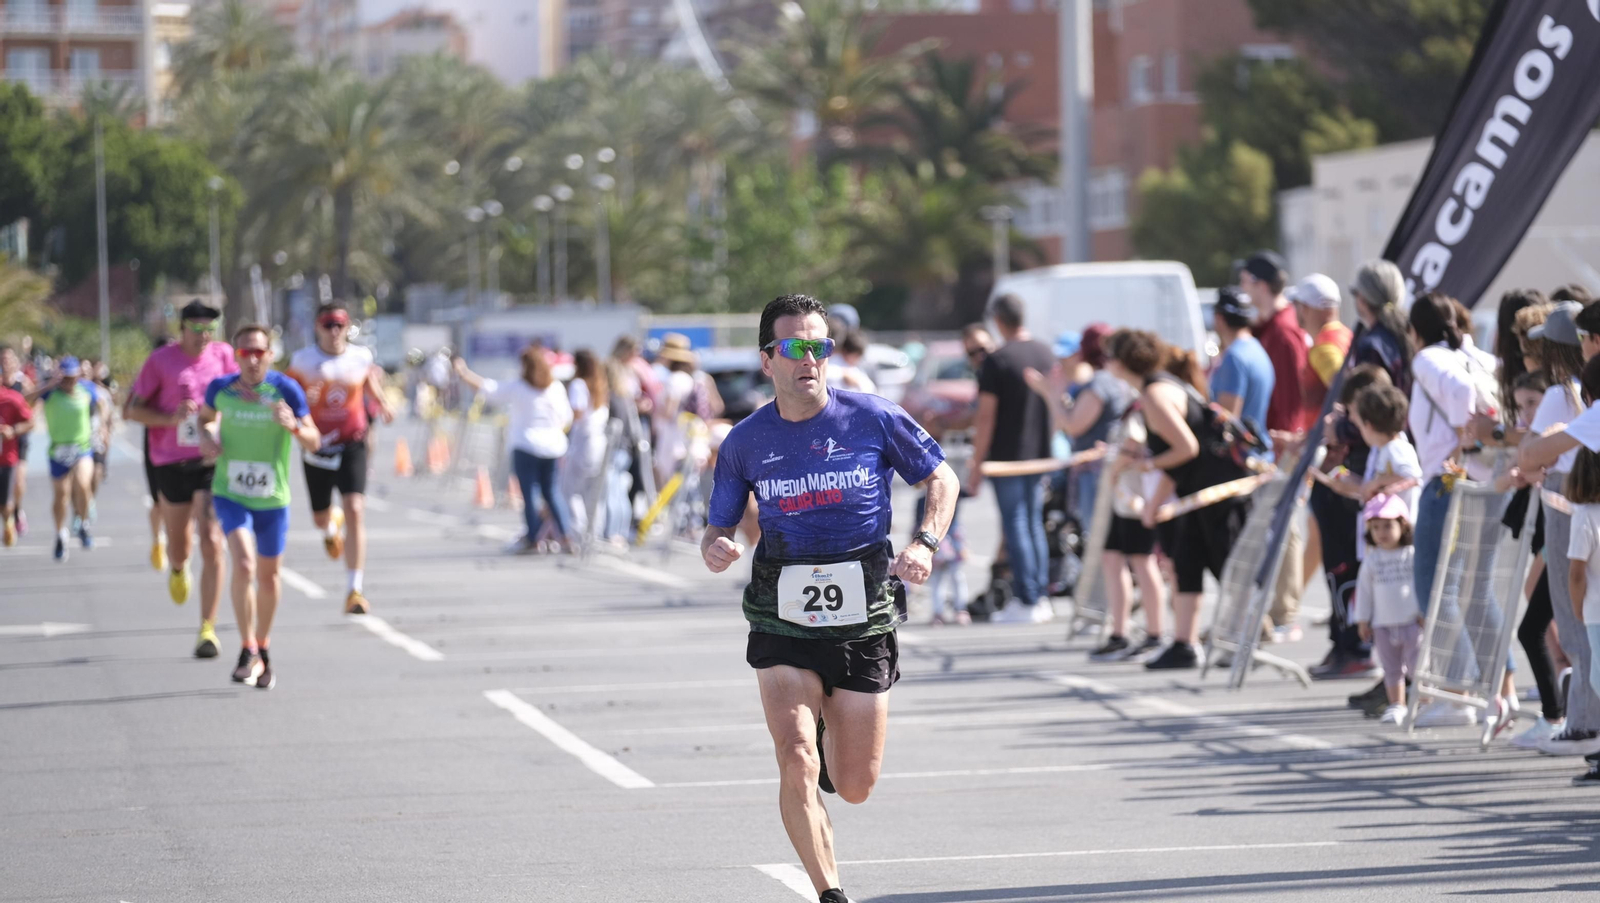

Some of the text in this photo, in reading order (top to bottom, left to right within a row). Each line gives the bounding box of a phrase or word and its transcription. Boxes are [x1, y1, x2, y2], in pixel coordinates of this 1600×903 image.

[236, 473, 267, 489] 404
[771, 478, 808, 498] MEDIA
[807, 465, 869, 491] MARATÓN
[779, 488, 842, 512] CALAR ALTO
[802, 584, 843, 612] 29
